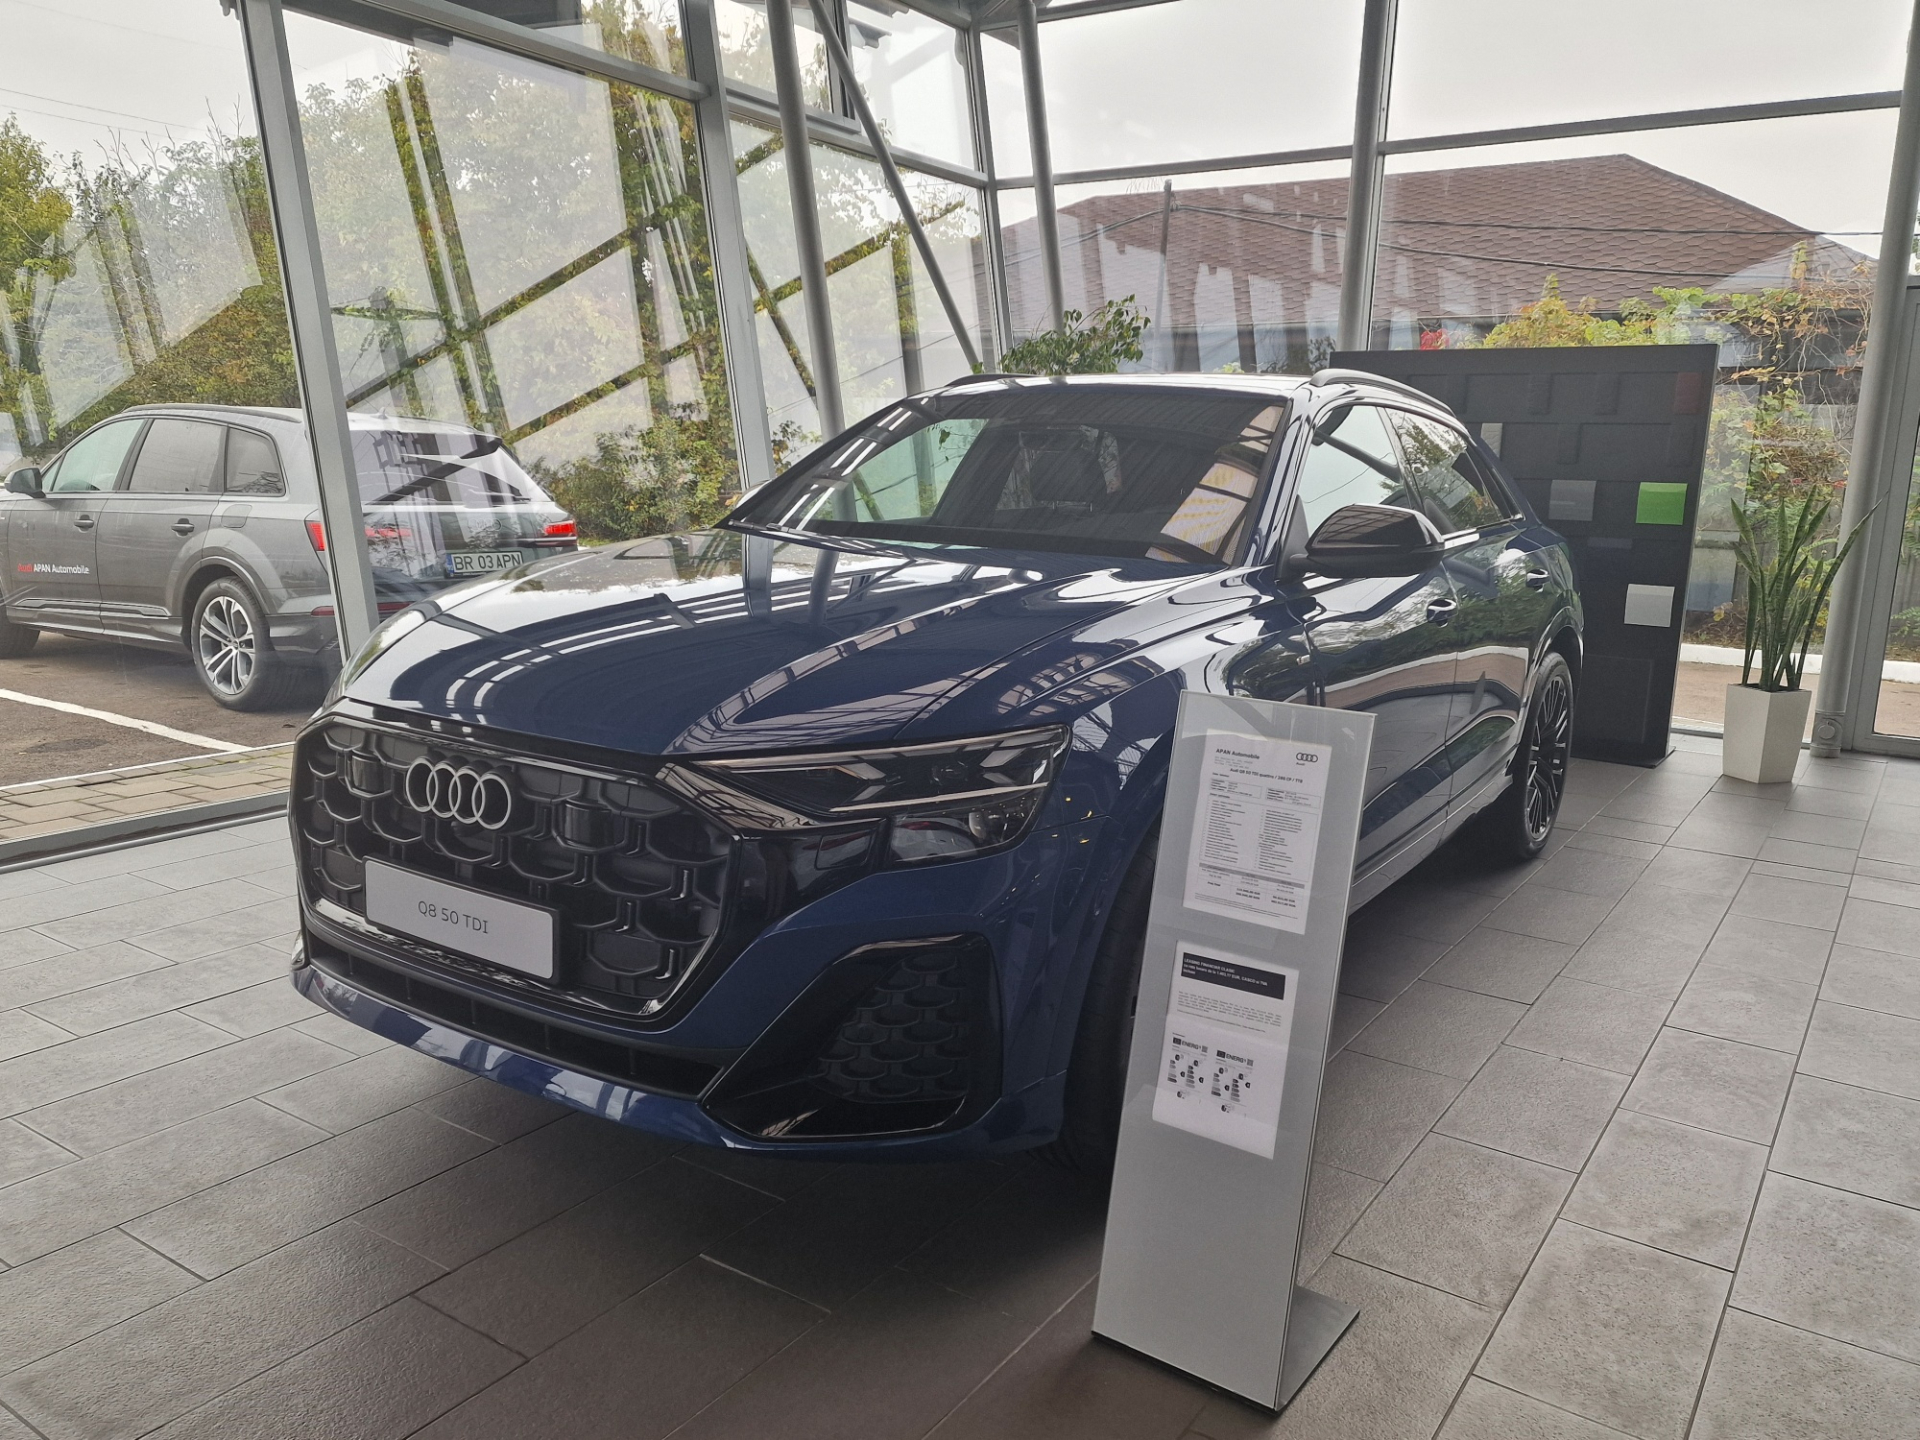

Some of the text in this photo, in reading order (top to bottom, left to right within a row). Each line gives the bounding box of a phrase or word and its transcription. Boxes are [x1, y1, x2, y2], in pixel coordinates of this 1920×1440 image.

[34, 563, 51, 573] APAN
[52, 564, 90, 574] Automobile
[453, 556, 474, 570] BR
[478, 555, 494, 569] 03
[496, 554, 520, 569] APN
[1232, 751, 1260, 760] Automobile
[418, 900, 488, 934] Q8 50 TDI
